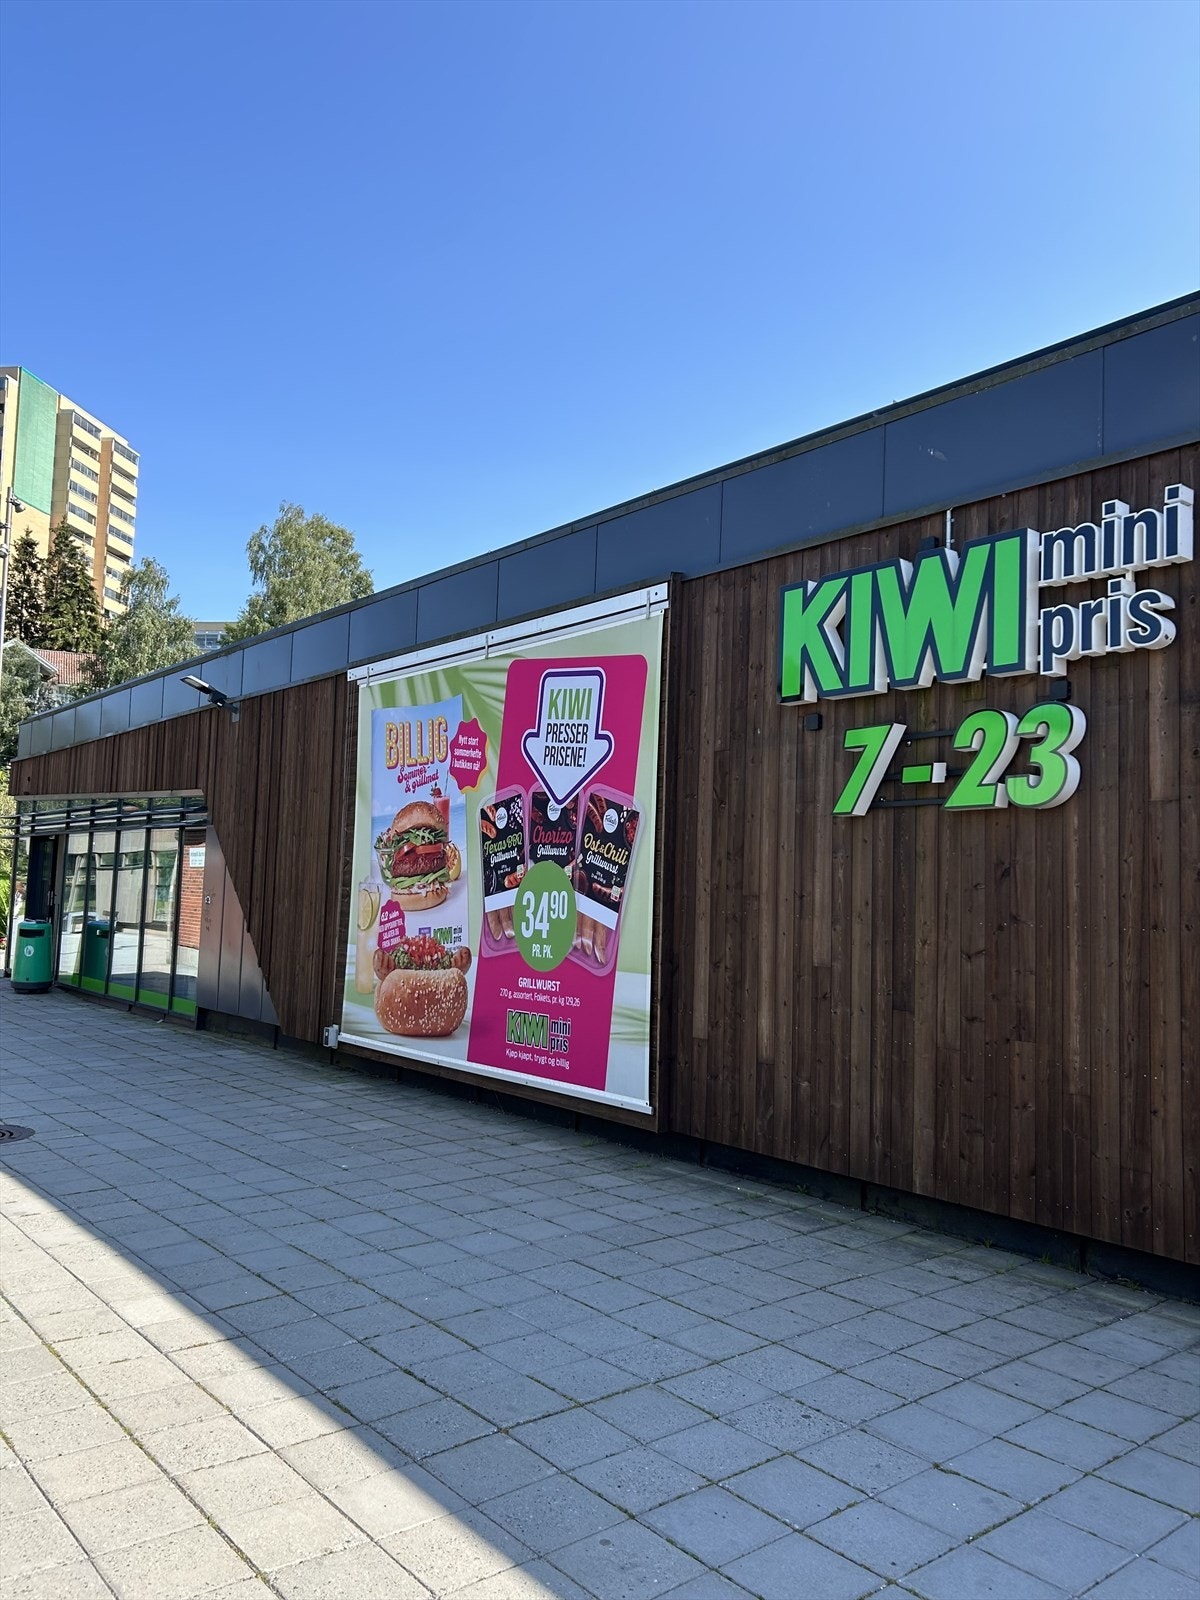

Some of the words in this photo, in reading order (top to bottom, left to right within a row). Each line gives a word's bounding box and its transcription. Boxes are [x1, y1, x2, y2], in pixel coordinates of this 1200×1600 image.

[1040, 484, 1193, 587] mini
[778, 528, 1036, 704] KIWI
[1040, 577, 1176, 677] pris
[547, 687, 592, 720] KIWI
[385, 715, 448, 769] BILLIG
[458, 734, 468, 746] Nytt
[545, 722, 589, 744] PRESSER
[543, 745, 587, 768] PRISENE!
[404, 779, 412, 793] &
[411, 769, 439, 793] grillmat
[533, 825, 574, 844] Chorizo
[490, 847, 517, 867] Grillwurst
[537, 843, 568, 858] Grillwurst
[585, 850, 619, 875] Grillwurst
[532, 944, 541, 957] PR.
[543, 944, 553, 959] PK.
[518, 977, 560, 992] GRILLWURST
[500, 988, 508, 997] 270
[558, 995, 565, 1006] kg
[506, 1008, 550, 1051] KIWI
[550, 1016, 572, 1037] mini
[550, 1034, 569, 1055] pris
[506, 1048, 517, 1059] Kjøp
[534, 1053, 547, 1064] trygt
[548, 1057, 556, 1067] og
[556, 1057, 569, 1070] billig
